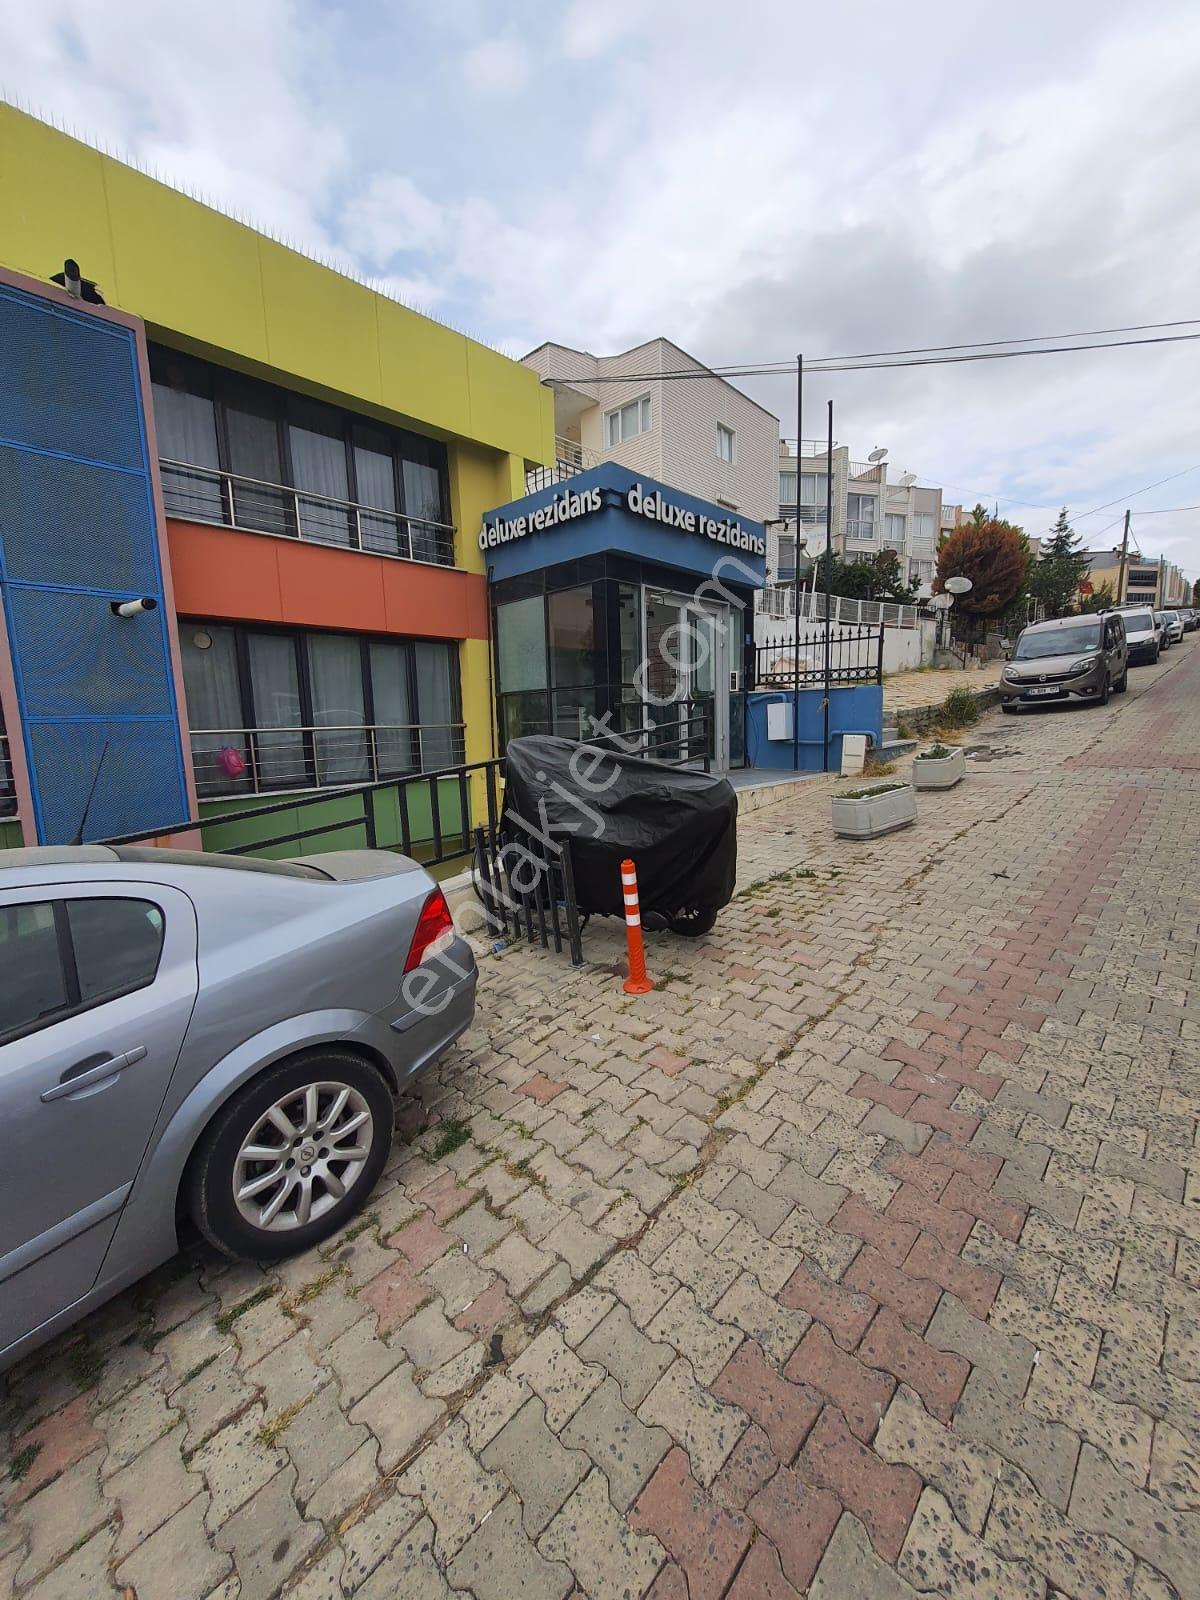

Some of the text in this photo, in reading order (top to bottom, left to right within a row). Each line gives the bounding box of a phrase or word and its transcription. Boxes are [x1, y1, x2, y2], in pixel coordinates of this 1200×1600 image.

[478, 487, 602, 550] deluxe rezidans
[627, 483, 766, 555] deluxe rezidans
